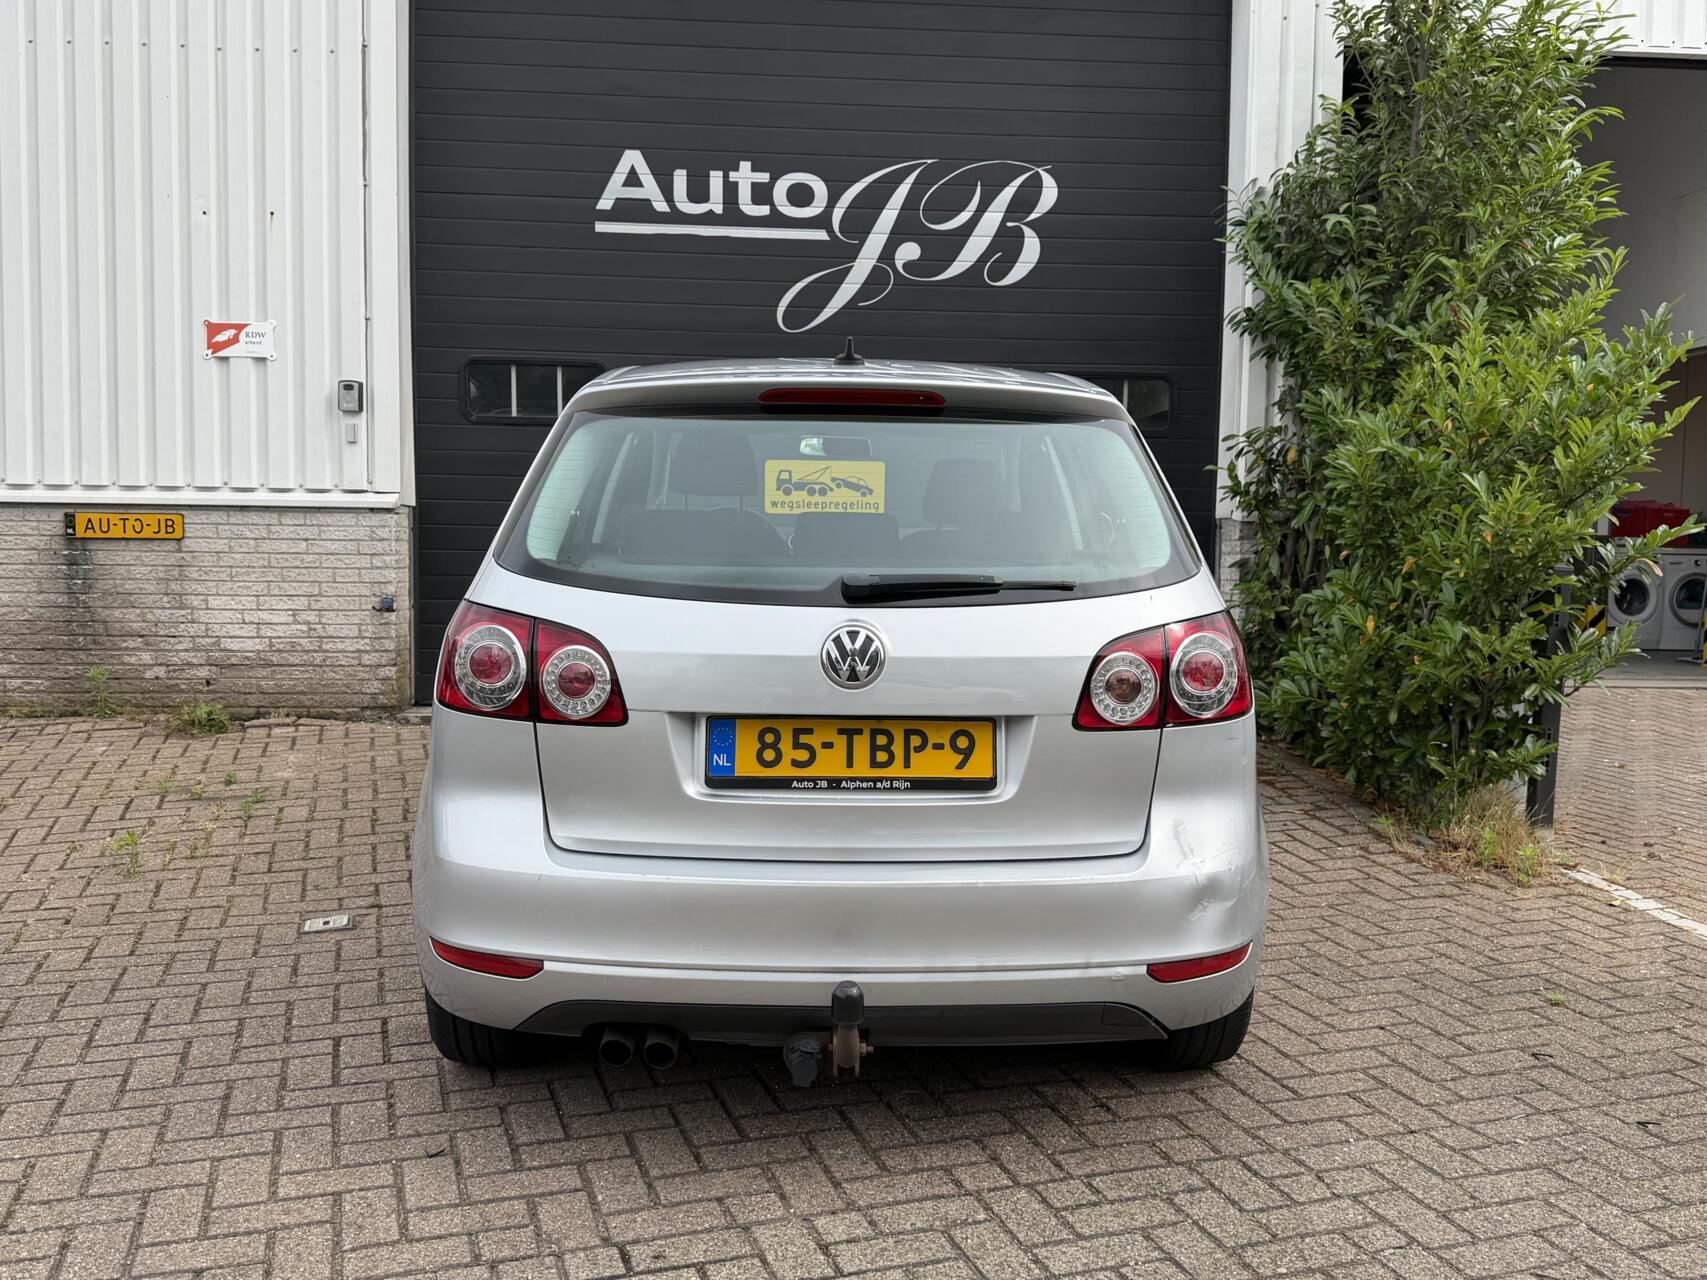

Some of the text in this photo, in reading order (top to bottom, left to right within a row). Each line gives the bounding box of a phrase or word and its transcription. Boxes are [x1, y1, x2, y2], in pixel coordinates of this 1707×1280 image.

[595, 149, 1058, 333] Auto JB
[770, 499, 880, 513] wegsleepregeling
[83, 517, 176, 534] AU-TO-JB
[713, 726, 976, 769] NL 85-TBP-9
[791, 780, 814, 788] Auto
[816, 780, 828, 788] JB
[840, 780, 874, 790] Alphen
[876, 780, 891, 789] a/d
[892, 780, 911, 790] Rijn
